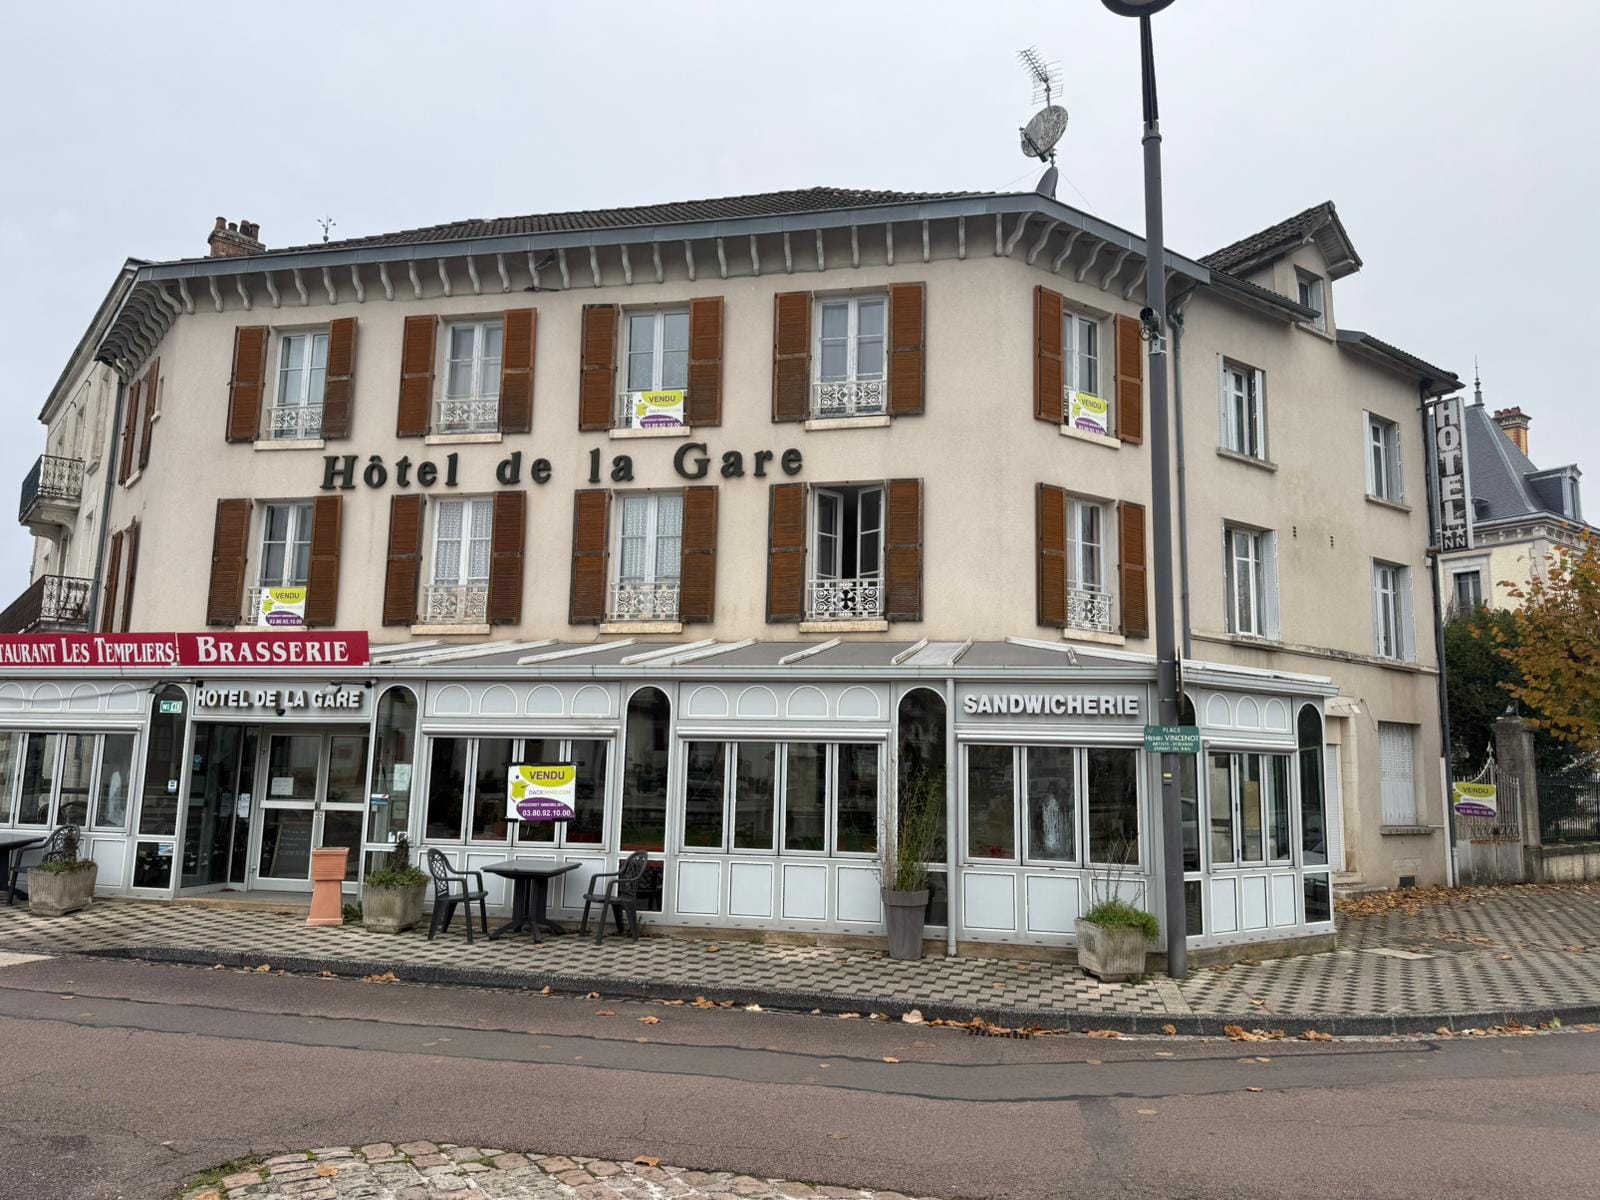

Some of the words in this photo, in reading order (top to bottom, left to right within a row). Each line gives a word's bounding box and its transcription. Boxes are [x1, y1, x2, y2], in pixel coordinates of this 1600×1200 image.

[1081, 398, 1102, 410] VENDU
[320, 452, 459, 490] Hôtel
[496, 451, 552, 485] de
[588, 447, 634, 484] la
[673, 442, 803, 479] Gare
[1435, 401, 1464, 526] HOTEL
[196, 636, 349, 662] BRASSERIE
[196, 689, 249, 708] HOTEL
[254, 690, 276, 708] DE
[283, 690, 304, 708] LA
[311, 689, 361, 709] GARE
[963, 694, 1140, 715] SANDWICHERIE
[1164, 734, 1199, 742] VINCENOT
[529, 770, 565, 780] VENDU
[1462, 786, 1489, 794] VENDU
[522, 809, 571, 817] 03.80.92.10.00
